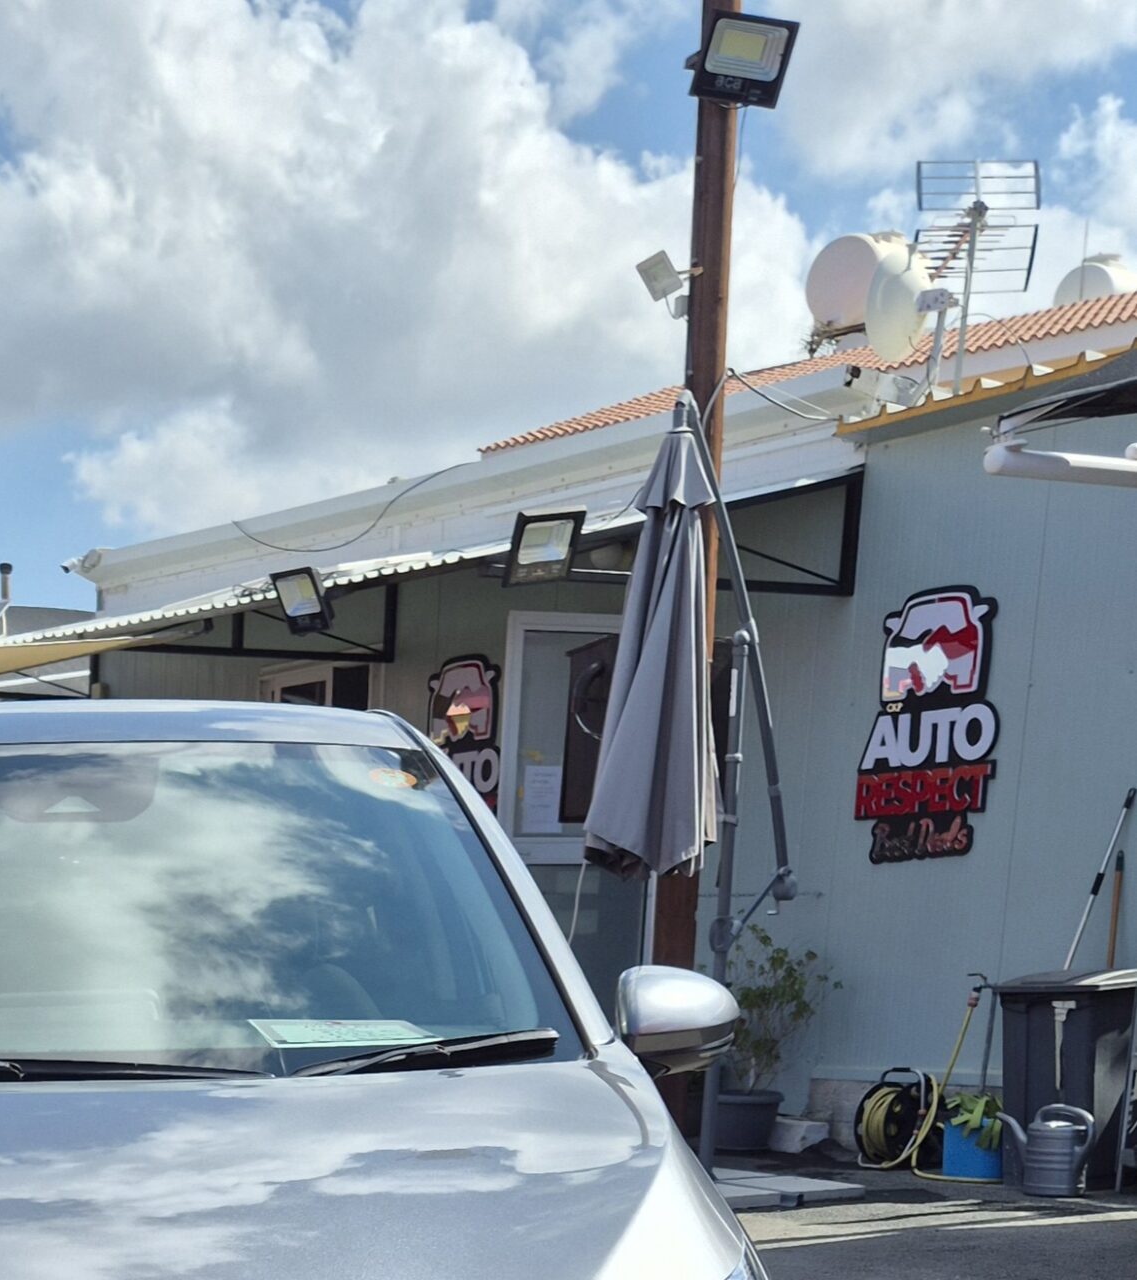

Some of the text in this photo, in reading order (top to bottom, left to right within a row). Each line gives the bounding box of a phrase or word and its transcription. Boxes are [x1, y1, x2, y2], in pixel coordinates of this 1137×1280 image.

[860, 703, 996, 770] AUTO
[441, 747, 499, 793] TO
[854, 764, 992, 818] RESPECT
